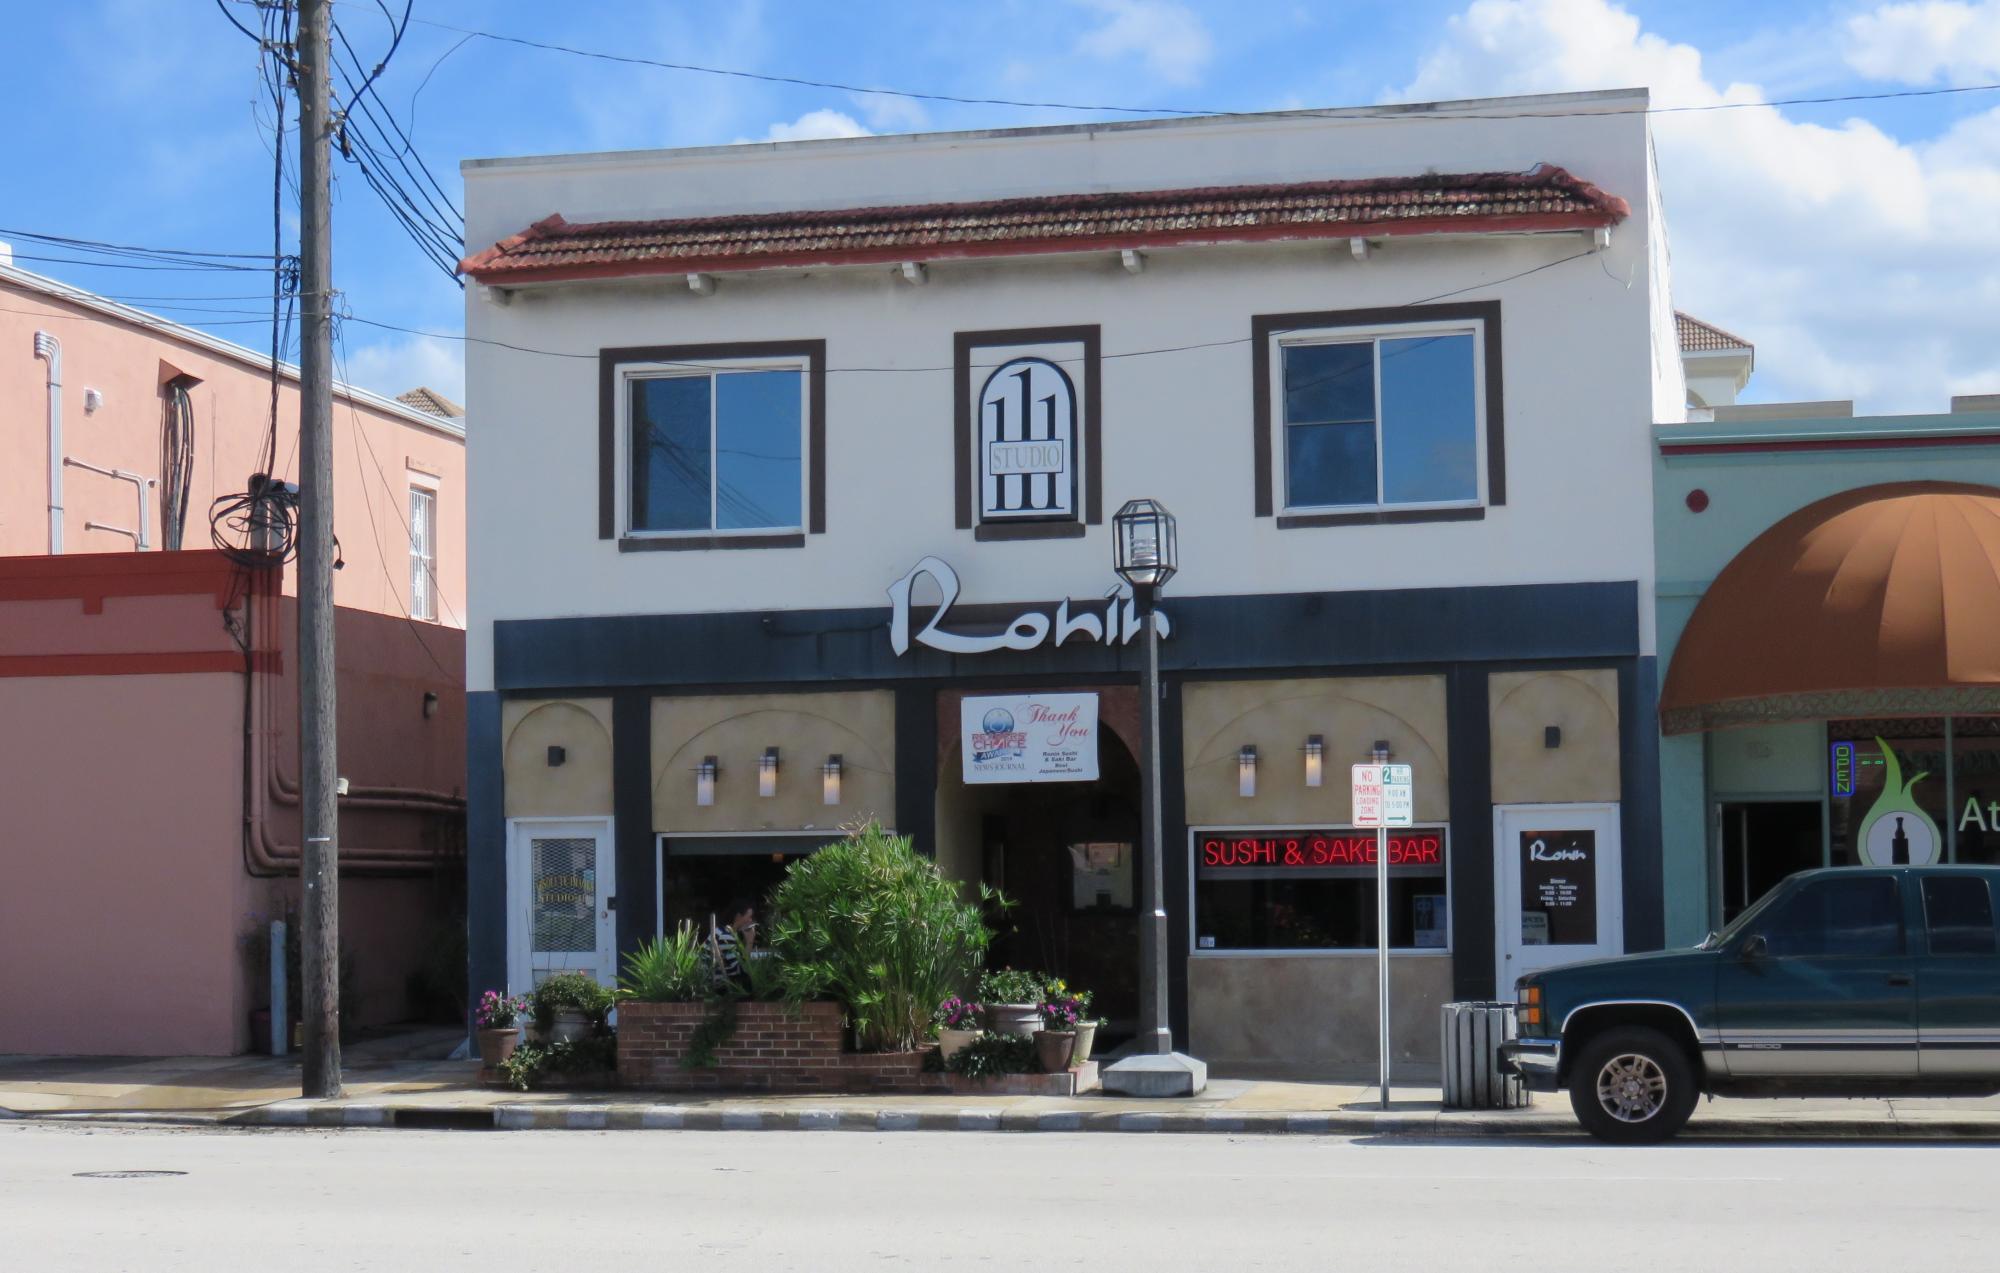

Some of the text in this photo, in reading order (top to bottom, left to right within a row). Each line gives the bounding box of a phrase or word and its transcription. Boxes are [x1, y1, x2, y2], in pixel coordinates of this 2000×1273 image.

[992, 445, 1061, 470] STUDIO
[887, 555, 1171, 657] Ronin
[1016, 703, 1080, 725] Thank
[1046, 720, 1089, 747] You
[1361, 770, 1373, 782] NO
[1383, 767, 1391, 783] 2
[1836, 746, 1850, 793] OPEN
[1354, 784, 1381, 796] PARKING
[1356, 797, 1380, 805] LOADING
[1360, 806, 1375, 814] ZONE
[1205, 839, 1438, 865] SUSHI & SAKE BAR
[1530, 839, 1587, 861] Ronin
